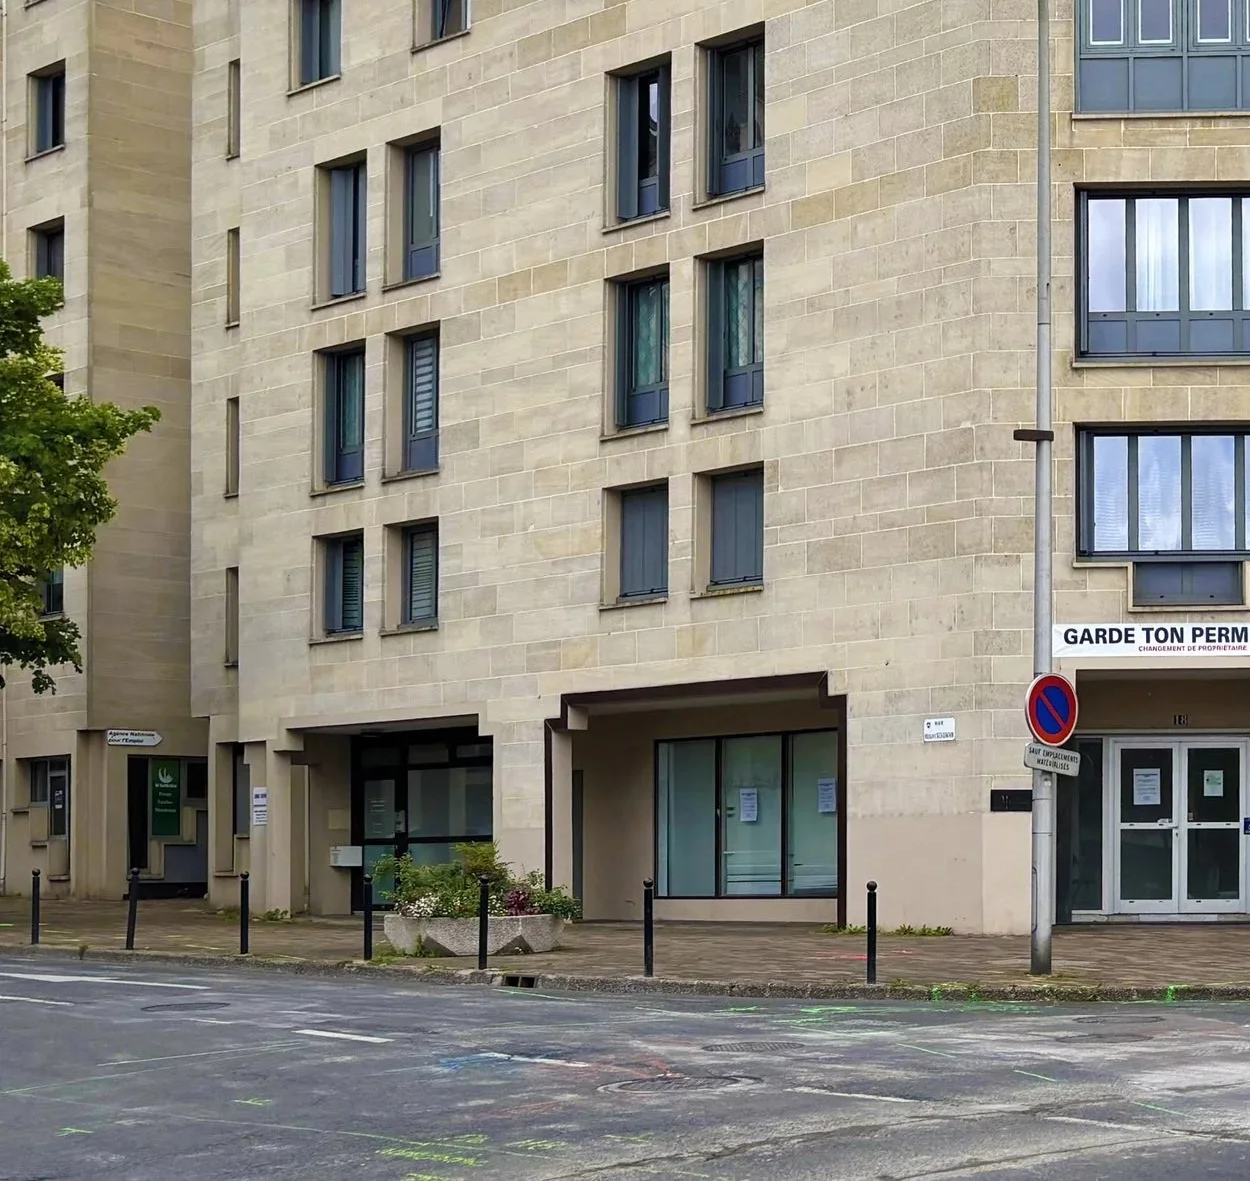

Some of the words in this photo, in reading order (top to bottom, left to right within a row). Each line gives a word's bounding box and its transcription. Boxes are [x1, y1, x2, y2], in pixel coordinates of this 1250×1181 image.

[1063, 627, 1135, 645] GARDE
[1142, 626, 1184, 644] TON
[1028, 746, 1041, 755] SAUF
[1042, 749, 1079, 764] EMPLACEMENTS
